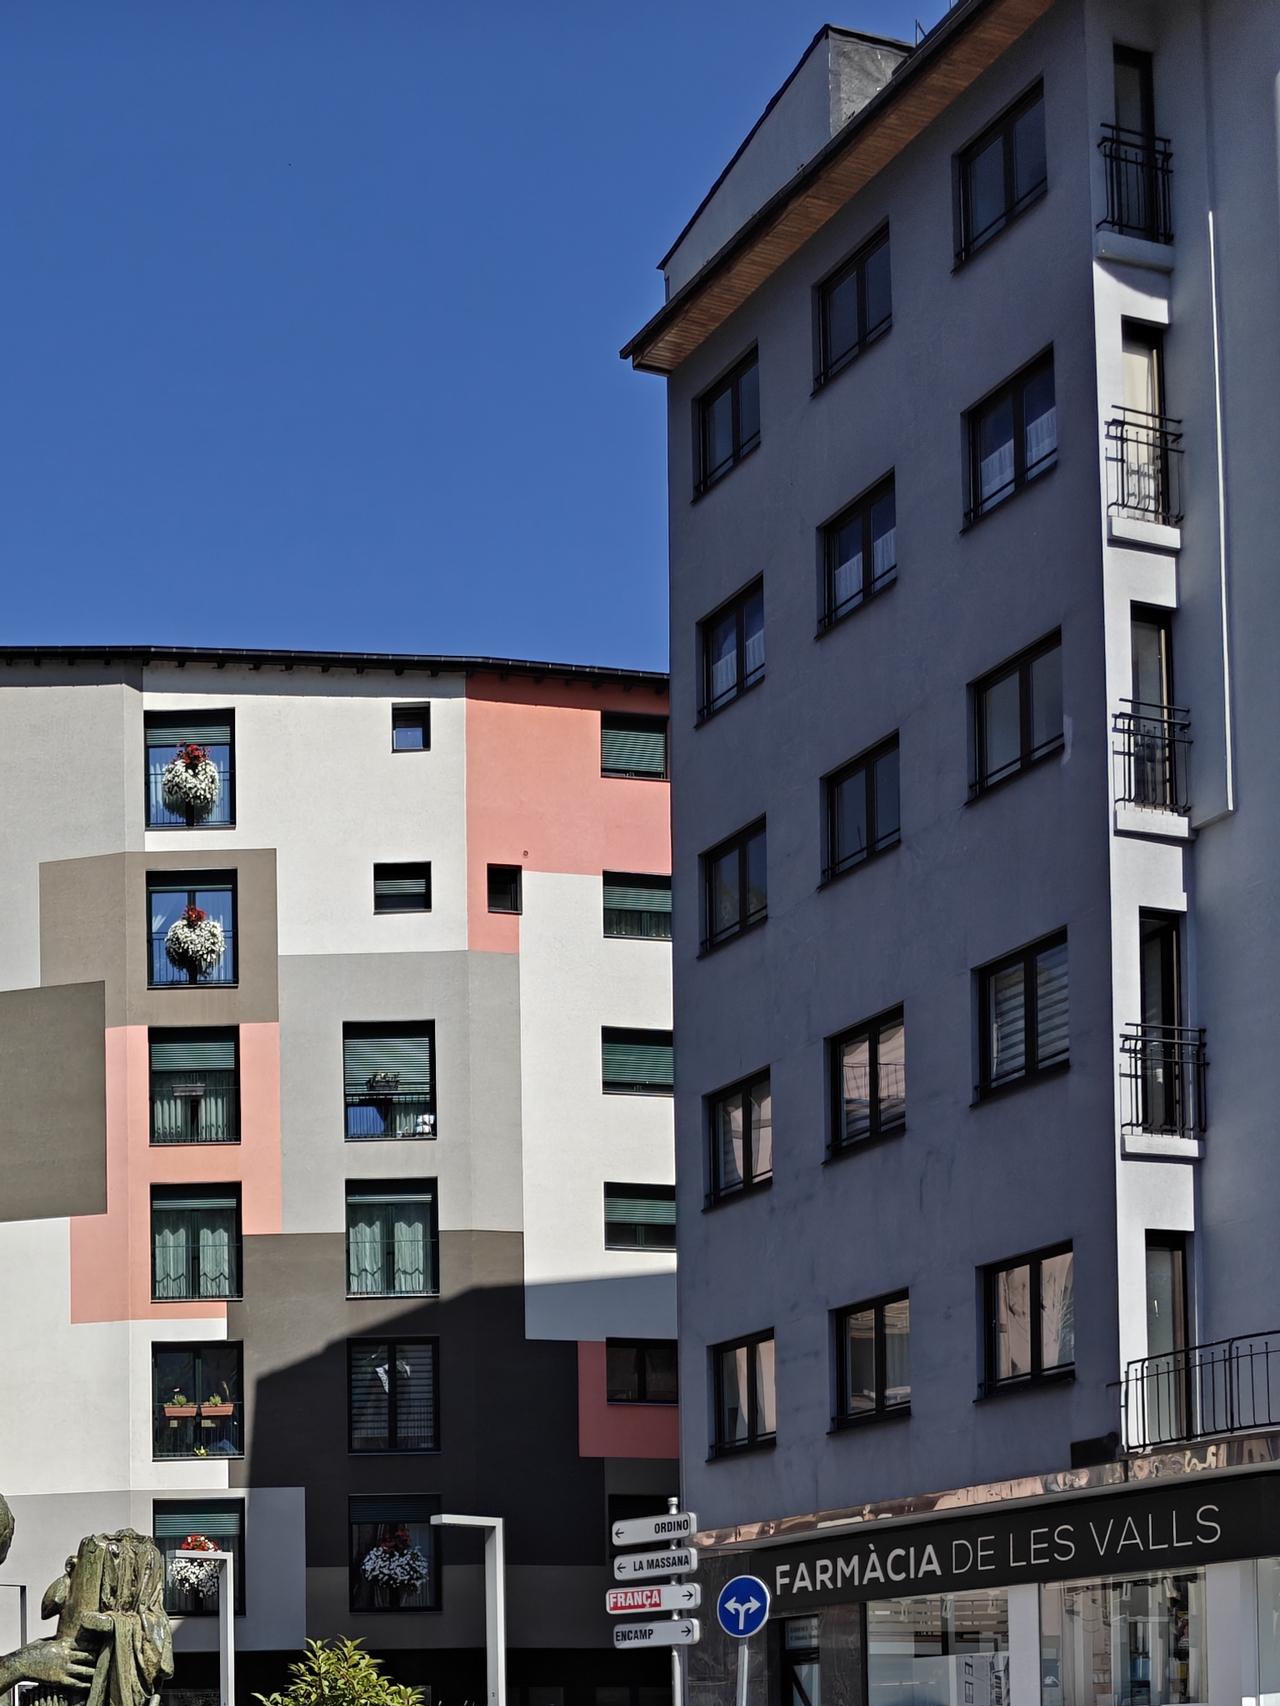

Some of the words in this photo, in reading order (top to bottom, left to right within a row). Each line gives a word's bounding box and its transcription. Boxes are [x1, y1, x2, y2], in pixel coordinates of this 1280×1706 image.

[654, 1519, 689, 1534] ORDINO
[775, 1543, 942, 1596] FARMÀCIA
[952, 1535, 996, 1574] DE
[1009, 1524, 1076, 1567] LES
[1089, 1504, 1221, 1556] VALLS
[633, 1561, 644, 1572] LA
[646, 1555, 690, 1570] MASSANA
[609, 1590, 660, 1608] FRANÇA
[615, 1629, 654, 1641] ENCAMP
